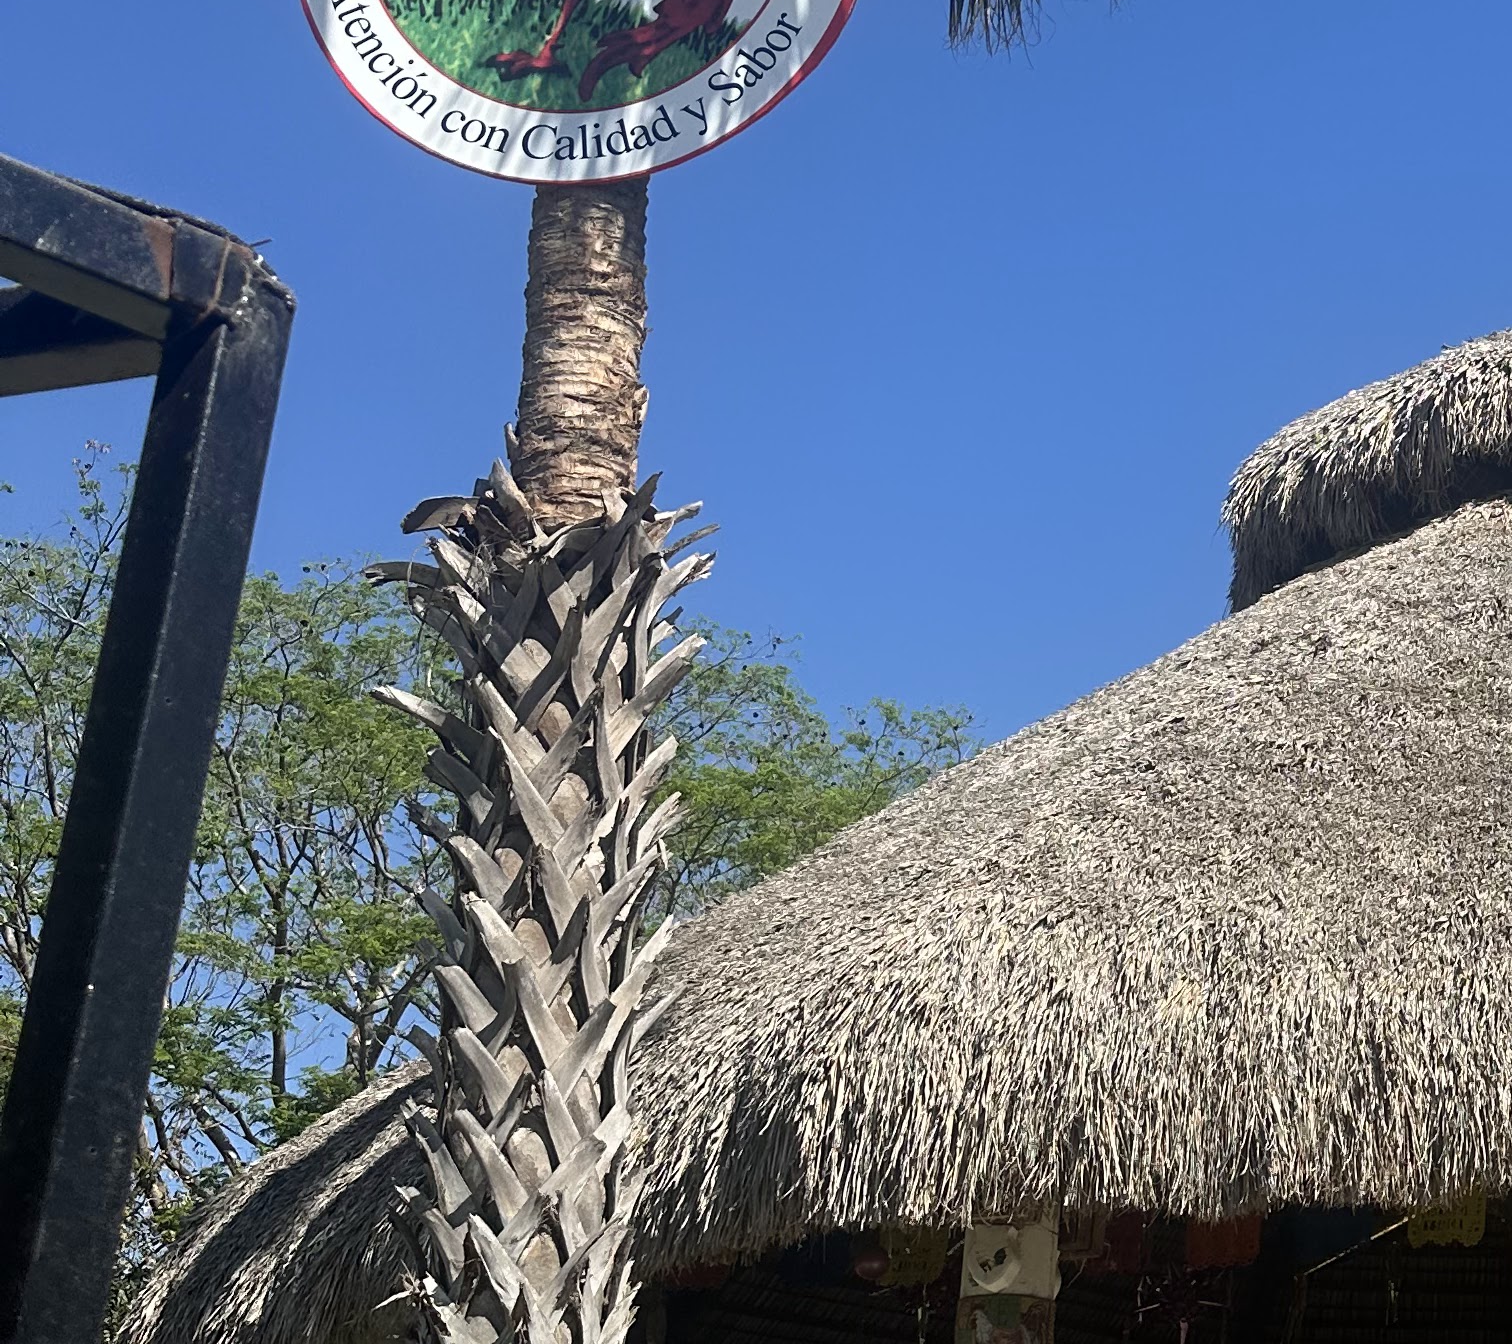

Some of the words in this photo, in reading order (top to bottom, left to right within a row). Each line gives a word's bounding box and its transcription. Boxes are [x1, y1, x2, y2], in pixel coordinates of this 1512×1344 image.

[441, 105, 510, 154] con
[521, 106, 680, 161] Calidad
[680, 97, 708, 136] y
[708, 12, 803, 107] Sabor
